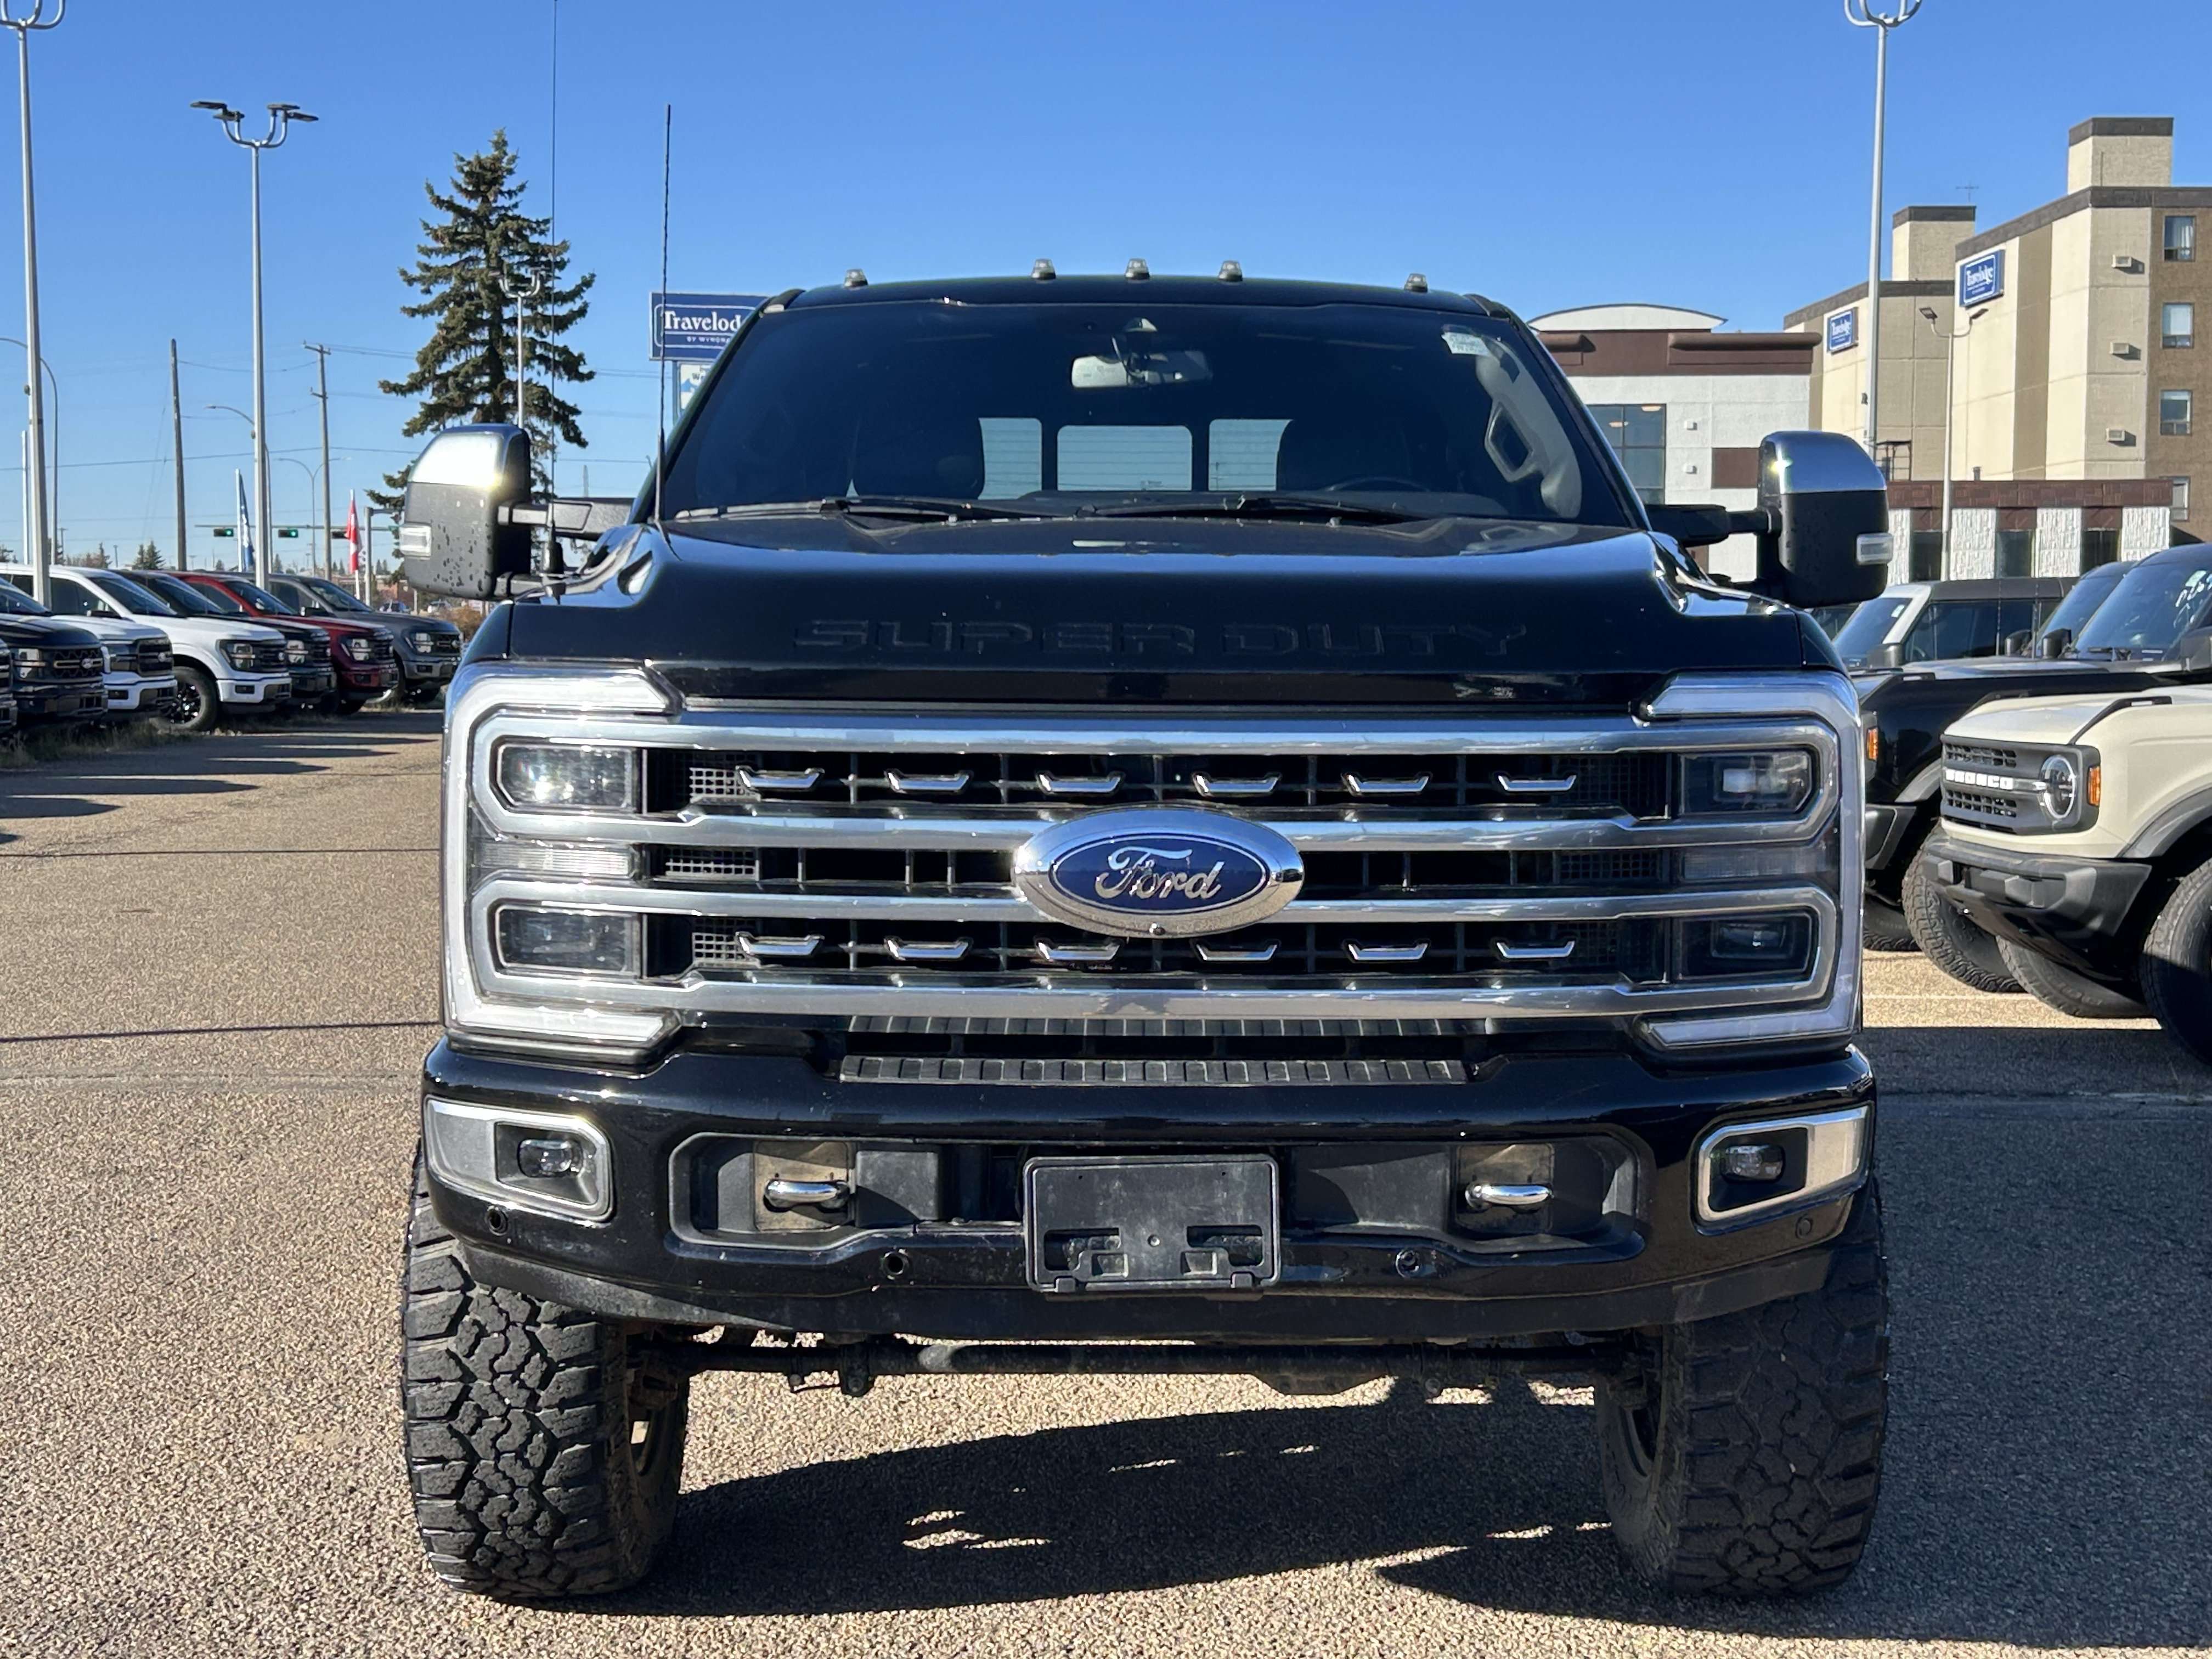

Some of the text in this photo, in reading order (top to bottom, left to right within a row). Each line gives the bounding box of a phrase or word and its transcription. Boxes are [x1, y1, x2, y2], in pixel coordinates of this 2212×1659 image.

[664, 311, 741, 331] Travelod
[794, 620, 1527, 656] SUPER DUTY
[1094, 846, 1225, 899] Ford
